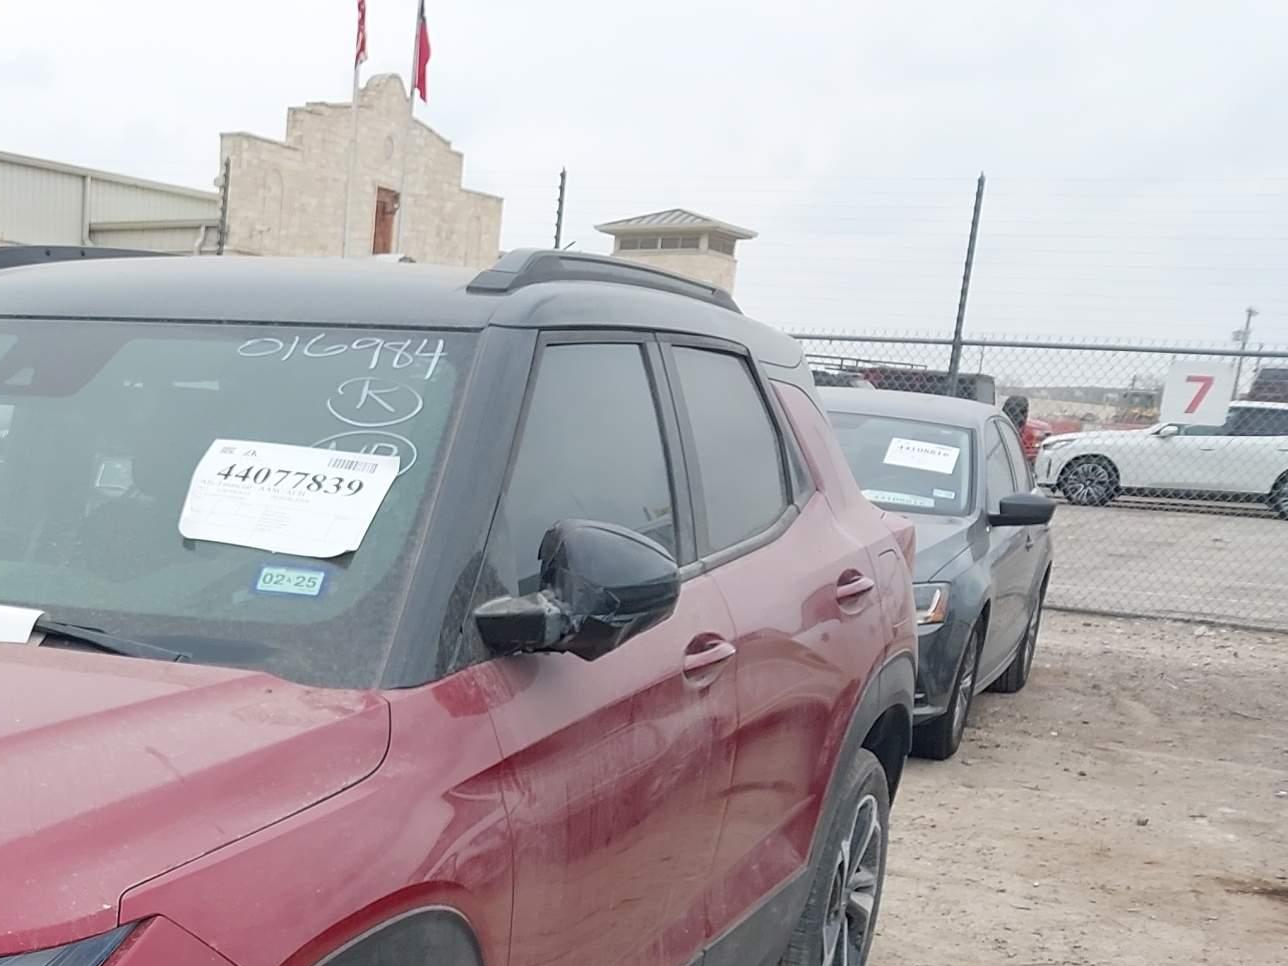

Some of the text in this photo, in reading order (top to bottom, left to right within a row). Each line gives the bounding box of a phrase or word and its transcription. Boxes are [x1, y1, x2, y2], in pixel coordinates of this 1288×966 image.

[236, 332, 448, 380] 016984
[1184, 375, 1214, 414] 7
[216, 463, 364, 497] 44077839
